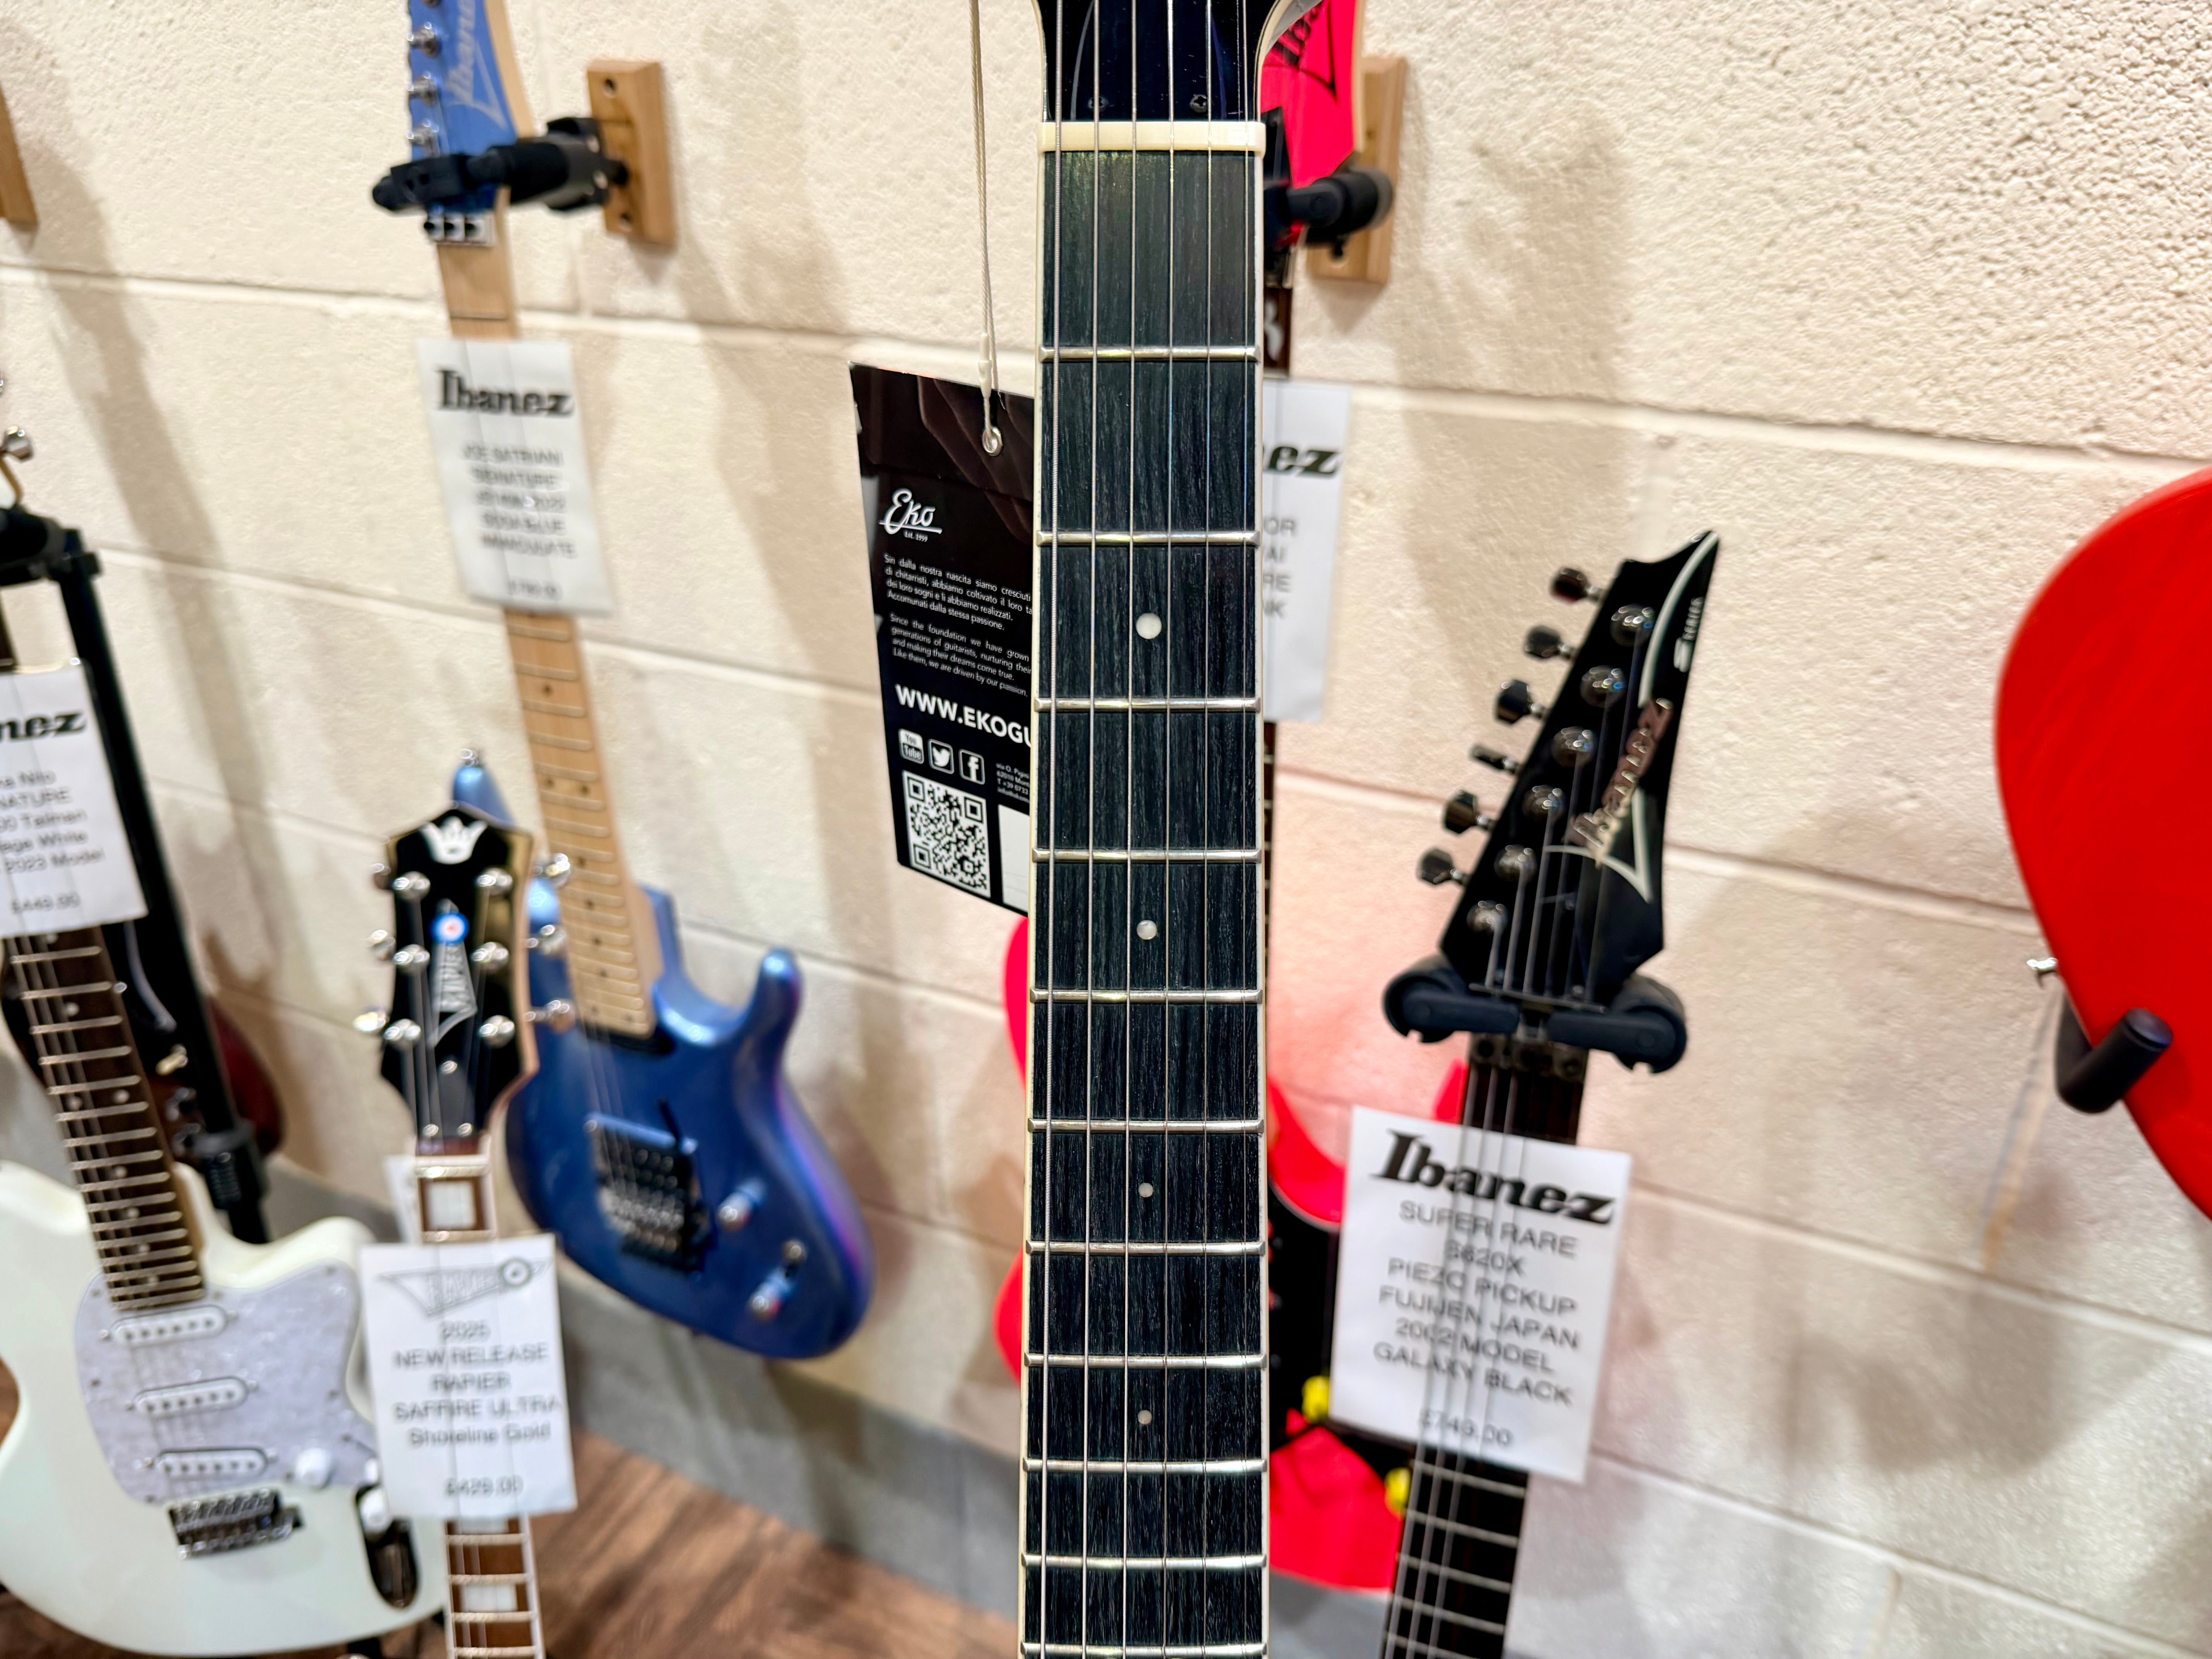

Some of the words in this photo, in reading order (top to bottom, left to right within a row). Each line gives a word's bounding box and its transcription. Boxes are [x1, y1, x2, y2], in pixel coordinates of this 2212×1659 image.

[435, 367, 575, 416] Ibanez
[1263, 445, 1339, 479] ez
[884, 488, 936, 534] Eko
[883, 553, 895, 564] Sin
[898, 558, 916, 570] dalla
[919, 564, 942, 577] nostra
[946, 571, 971, 584] nascita
[975, 580, 997, 591] siamo
[1001, 587, 1030, 601] cresciuti
[885, 565, 893, 575] di
[931, 578, 963, 594] abbiamo
[966, 589, 997, 604] coltivato
[1000, 597, 1005, 606] il
[1008, 598, 1022, 611] loro
[886, 577, 897, 588] dei
[898, 581, 913, 592] loro
[914, 587, 933, 599] sogni
[941, 591, 946, 601] li
[947, 594, 979, 610] abbiamo
[981, 606, 1013, 620] realizzati.
[887, 589, 928, 608] Accomunati
[929, 601, 946, 613] dalla
[948, 608, 969, 620] stessa
[970, 615, 1004, 630] passione.
[890, 612, 908, 626] Since
[912, 620, 924, 630] the
[928, 623, 966, 643] foundation
[970, 638, 981, 646] we
[986, 640, 1002, 653] have
[1006, 650, 1029, 662] grown
[891, 627, 931, 644] generations
[933, 637, 941, 646] of
[944, 642, 977, 658] guitarists,
[980, 653, 1013, 670] nurturing
[1016, 663, 1031, 675] their
[892, 638, 905, 647] and
[907, 642, 931, 657] making
[933, 649, 948, 660] their
[950, 654, 975, 668] dreams
[977, 663, 997, 675] come
[998, 670, 1014, 680] true.
[893, 647, 907, 659] Like
[908, 653, 927, 666] them,
[928, 660, 939, 668] we
[940, 664, 951, 672] are
[953, 666, 975, 679] driven
[975, 672, 985, 684] by
[986, 678, 998, 686] our
[999, 682, 1028, 697] passion.
[903, 745, 921, 759] Tube
[1371, 1129, 1615, 1224] Ibanez
[1399, 1200, 1493, 1238] SUPER
[1501, 1222, 1578, 1258] RARE
[1388, 1257, 1467, 1291] PIEZO
[1475, 1278, 1577, 1316] PICKUP
[393, 1348, 445, 1367] NEW
[449, 1342, 548, 1364] RELEASE
[1460, 1334, 1555, 1372] MODEL
[1491, 1316, 1579, 1349] JAPAN
[431, 1371, 511, 1391] RAPIER
[1373, 1342, 1473, 1380] GALAXY
[1485, 1367, 1573, 1406] BLACK
[505, 1421, 550, 1441] Gold
